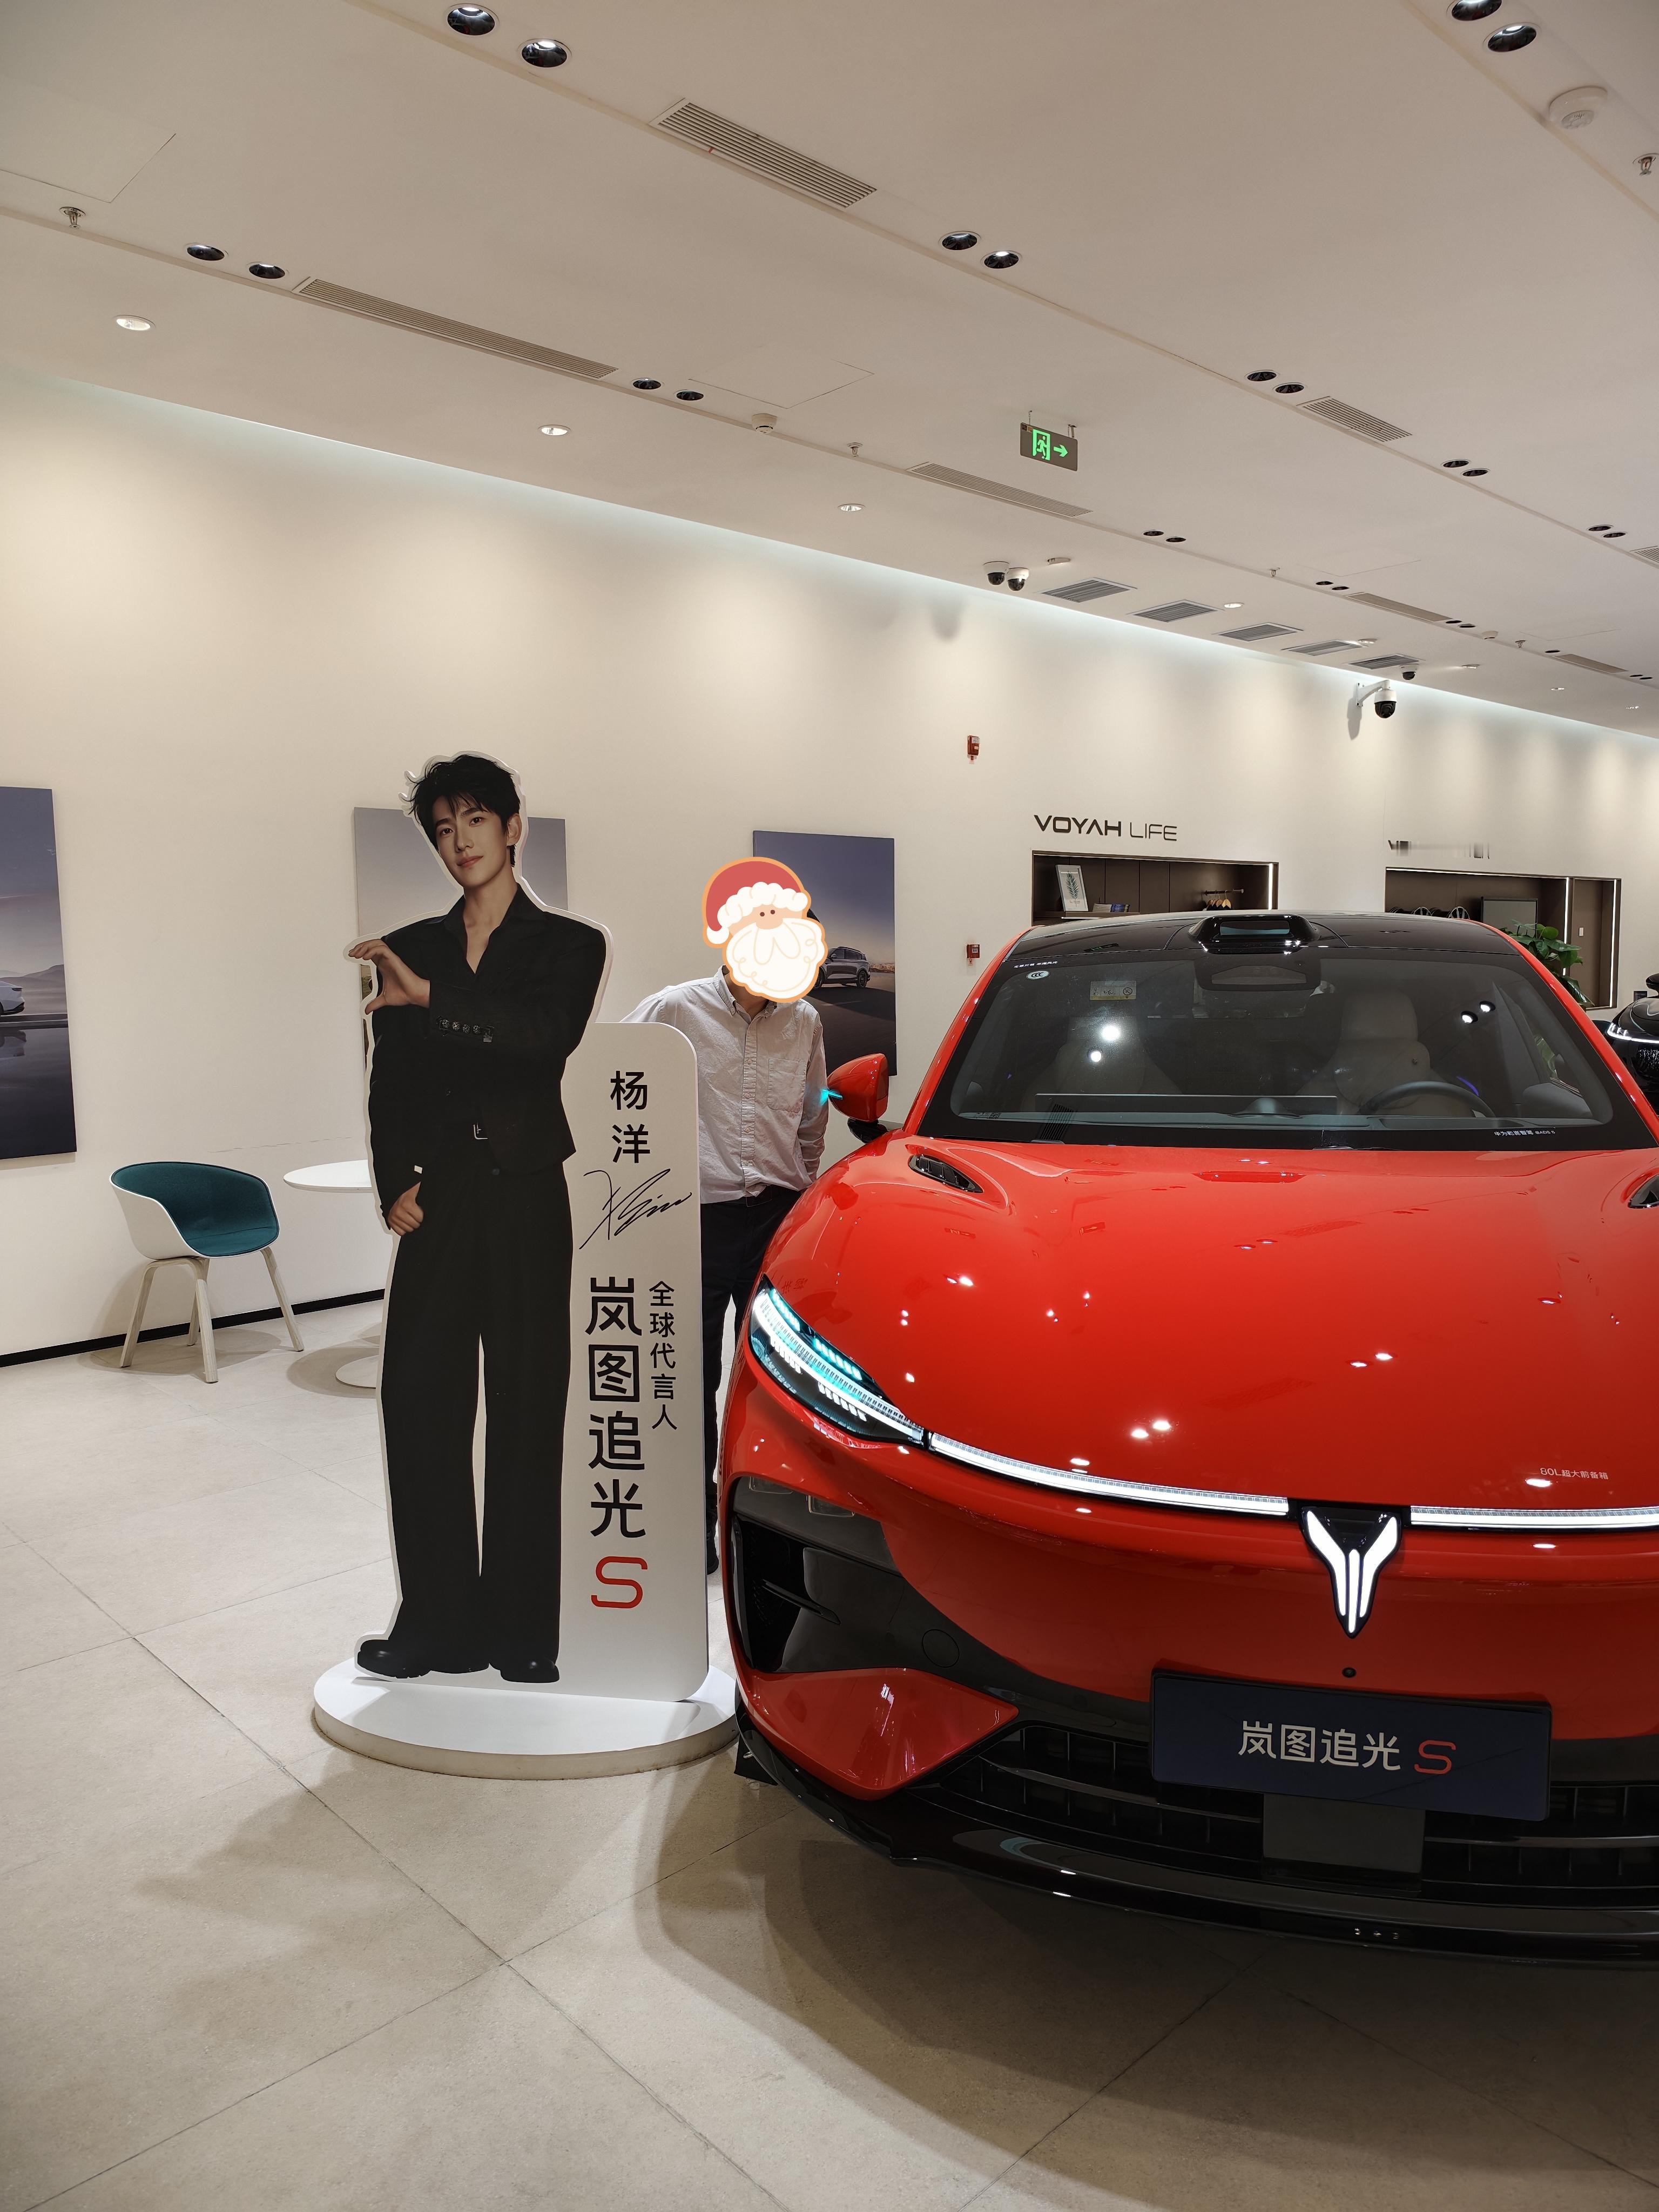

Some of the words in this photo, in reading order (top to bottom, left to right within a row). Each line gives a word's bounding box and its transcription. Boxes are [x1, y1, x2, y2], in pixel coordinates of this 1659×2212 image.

[1034, 814, 1122, 837] VOYAH
[1130, 821, 1177, 841] LIFE
[610, 1070, 651, 1164] 杨洋
[649, 1280, 678, 1431] 全球代言人
[584, 1276, 646, 1538] 岚图追光
[1540, 1467, 1609, 1480] 80L超大前备箱
[1238, 1720, 1401, 1771] 岚图追光
[1414, 1740, 1456, 1775] S
